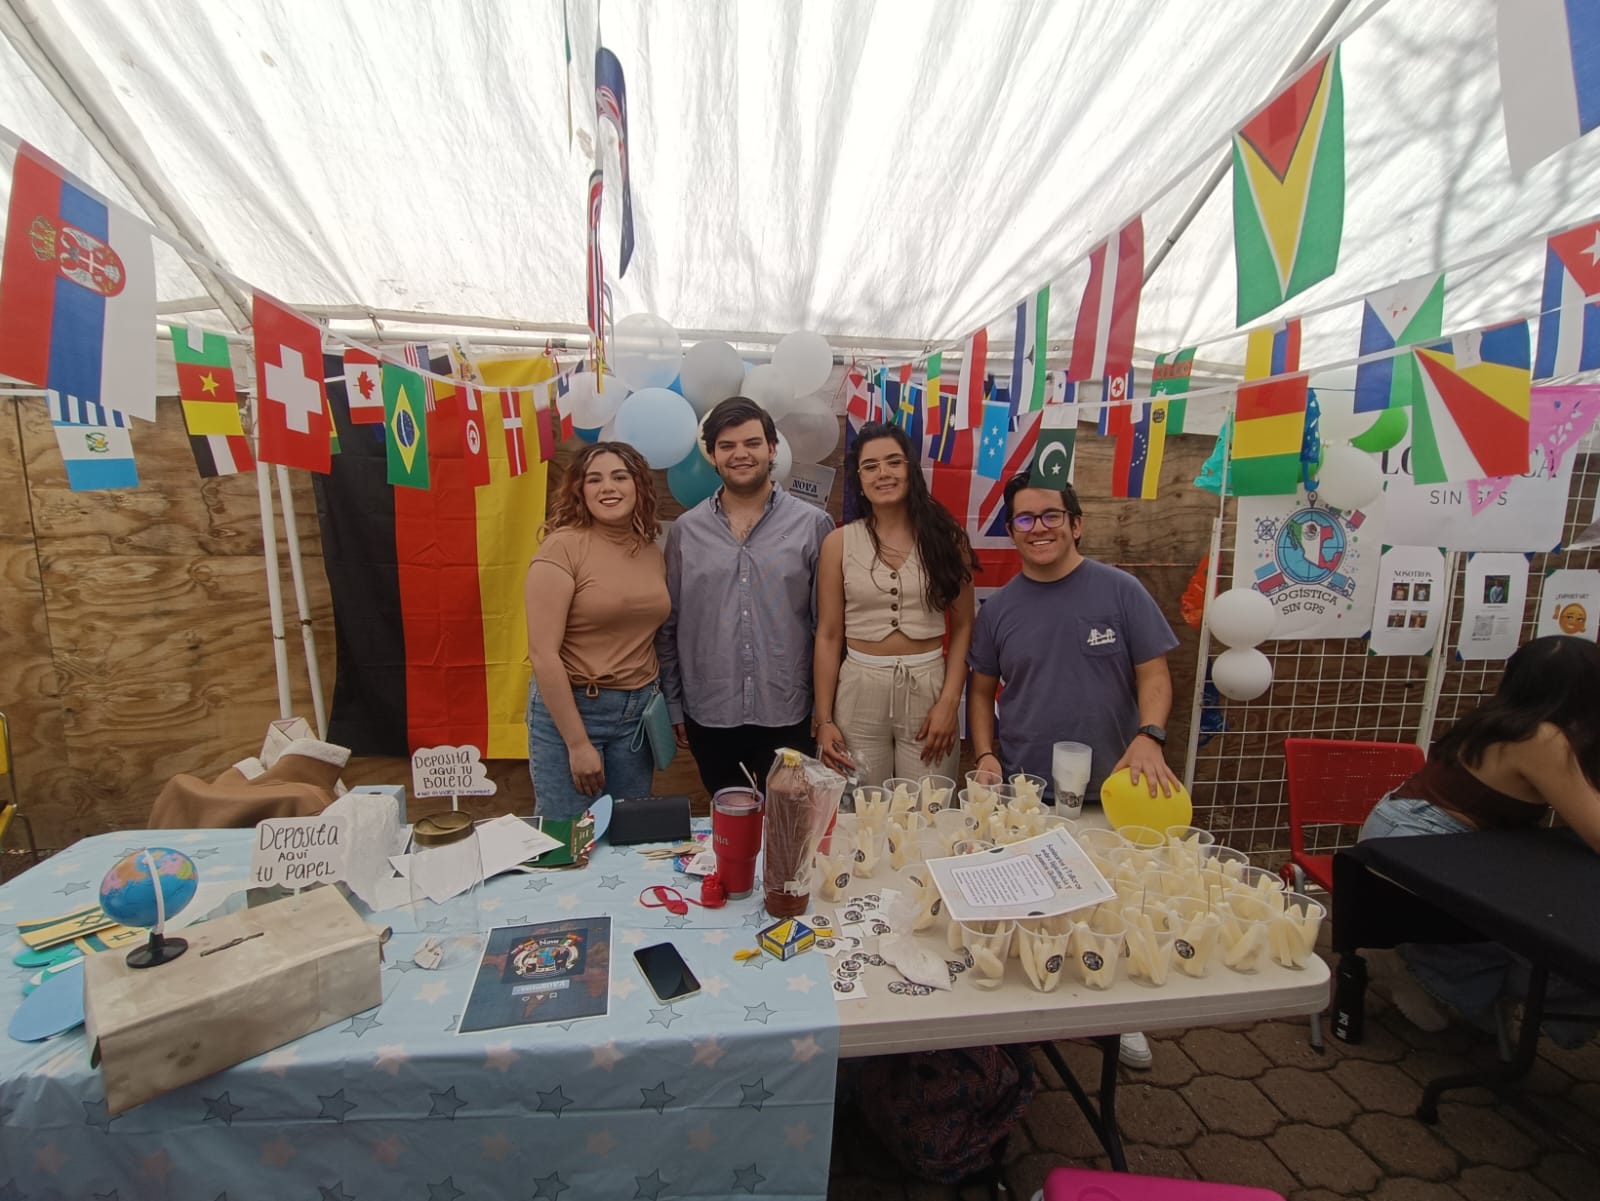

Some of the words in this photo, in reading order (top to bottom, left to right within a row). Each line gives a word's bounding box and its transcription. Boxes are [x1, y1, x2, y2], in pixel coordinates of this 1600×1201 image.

[792, 479, 818, 494] NOVA
[1429, 489, 1462, 505] SIN
[1269, 588, 1339, 606] LOGÍSTICA
[1281, 601, 1302, 615] SIN
[1303, 601, 1326, 615] GPS
[259, 823, 339, 851] Deposita
